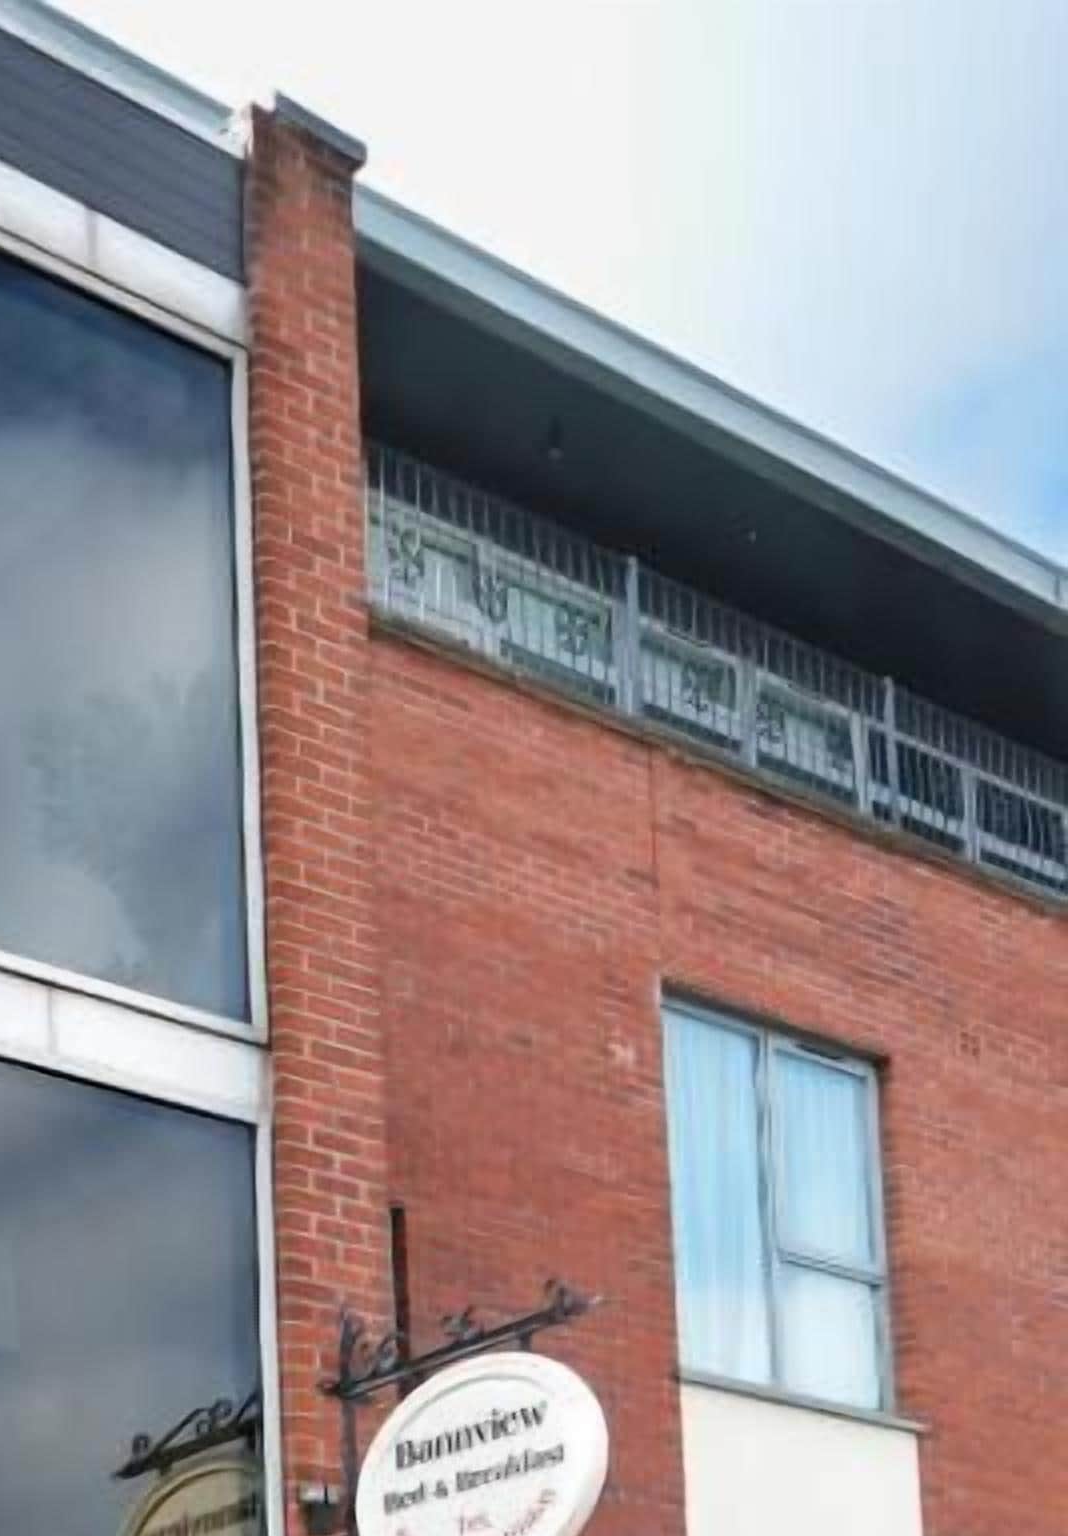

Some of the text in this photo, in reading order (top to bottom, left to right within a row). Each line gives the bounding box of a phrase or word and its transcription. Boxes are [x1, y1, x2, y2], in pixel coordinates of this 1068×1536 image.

[395, 1399, 547, 1471] Bannview
[383, 1444, 564, 1515] Bed & Breakfast
